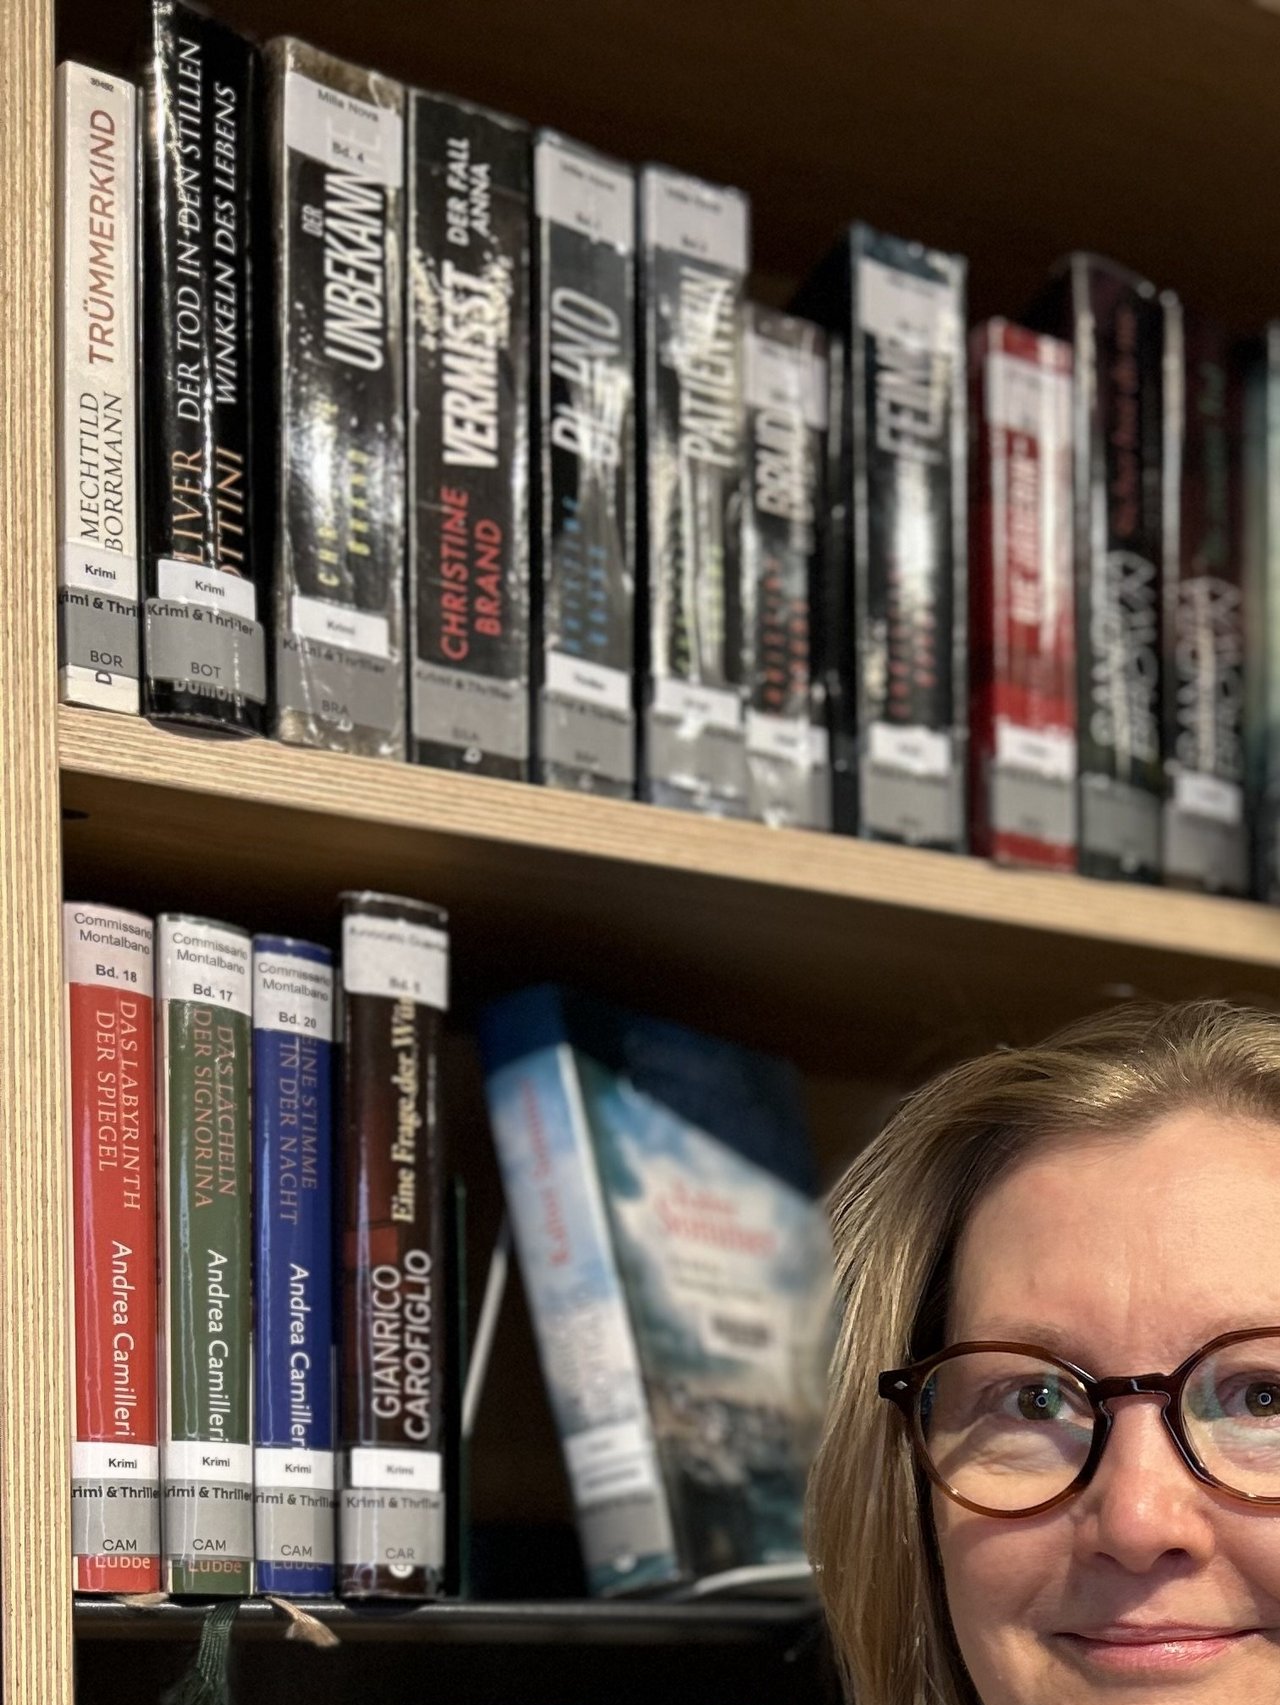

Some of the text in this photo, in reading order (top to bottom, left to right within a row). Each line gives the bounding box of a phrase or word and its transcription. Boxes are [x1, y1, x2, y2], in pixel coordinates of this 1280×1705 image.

[446, 137, 470, 247] DER FALL
[469, 162, 491, 237] ANNA
[177, 38, 202, 422] DER TOD IN DEN STILLEN
[302, 204, 324, 238] DER
[83, 109, 116, 366] TRÜMMERKIND
[213, 81, 238, 406] WINKELN DES LEBENS
[323, 172, 384, 371] UNBEKANN
[441, 261, 498, 468] VERMISST
[80, 391, 100, 542] MECHTILD
[104, 391, 124, 553] BORRMANN
[172, 449, 204, 563] LIVER
[215, 445, 244, 577] TTINI
[85, 564, 116, 580] Krimi
[440, 486, 470, 661] CHRISTINE
[473, 519, 502, 637] BRAND
[93, 597, 104, 610] &
[195, 580, 225, 597] Krimi
[148, 603, 189, 619] Krimi
[192, 606, 204, 621] &
[90, 650, 123, 667] BOR
[190, 662, 222, 679] BOT
[321, 699, 349, 717] BRA
[74, 911, 152, 941] Commissario
[79, 929, 151, 956] Montalbano
[171, 931, 248, 961] Commissario
[95, 964, 137, 983] Bd. 18
[176, 949, 245, 976] Montalbano
[257, 961, 331, 986] Commissario
[193, 983, 233, 1003] Bd. 17
[262, 977, 329, 1002] Montalbano
[278, 1011, 317, 1029] Bd. 20
[216, 1025, 236, 1076] DAS
[96, 1009, 118, 1172] DER SPIEGEL
[120, 999, 142, 1210] DAS LABYRINTH
[193, 1007, 214, 1209] DER SIGNORINA
[279, 1041, 298, 1225] IN DER NACHT
[301, 1093, 318, 1190] STIMME
[391, 1051, 423, 1224] Eine Frage der
[289, 1263, 312, 1346] Andrea
[111, 1239, 138, 1438] Andrea Camilleri
[207, 1248, 231, 1443] Andrea Camilleri
[371, 1264, 402, 1419] GIANRICO
[403, 1249, 432, 1441] CAROFIGLIO
[108, 1457, 138, 1470] Krimi
[202, 1456, 231, 1468] Krimi
[285, 1463, 312, 1475] Krimi
[386, 1464, 415, 1476] Krimi
[71, 1485, 160, 1500] rimi & Thrille
[198, 1486, 210, 1498] &
[256, 1492, 297, 1506] rimi &
[346, 1496, 398, 1509] Krimi &
[102, 1538, 137, 1552] CAM
[192, 1538, 227, 1551] CAM
[280, 1544, 313, 1557] CAM
[385, 1547, 415, 1560] CAR
